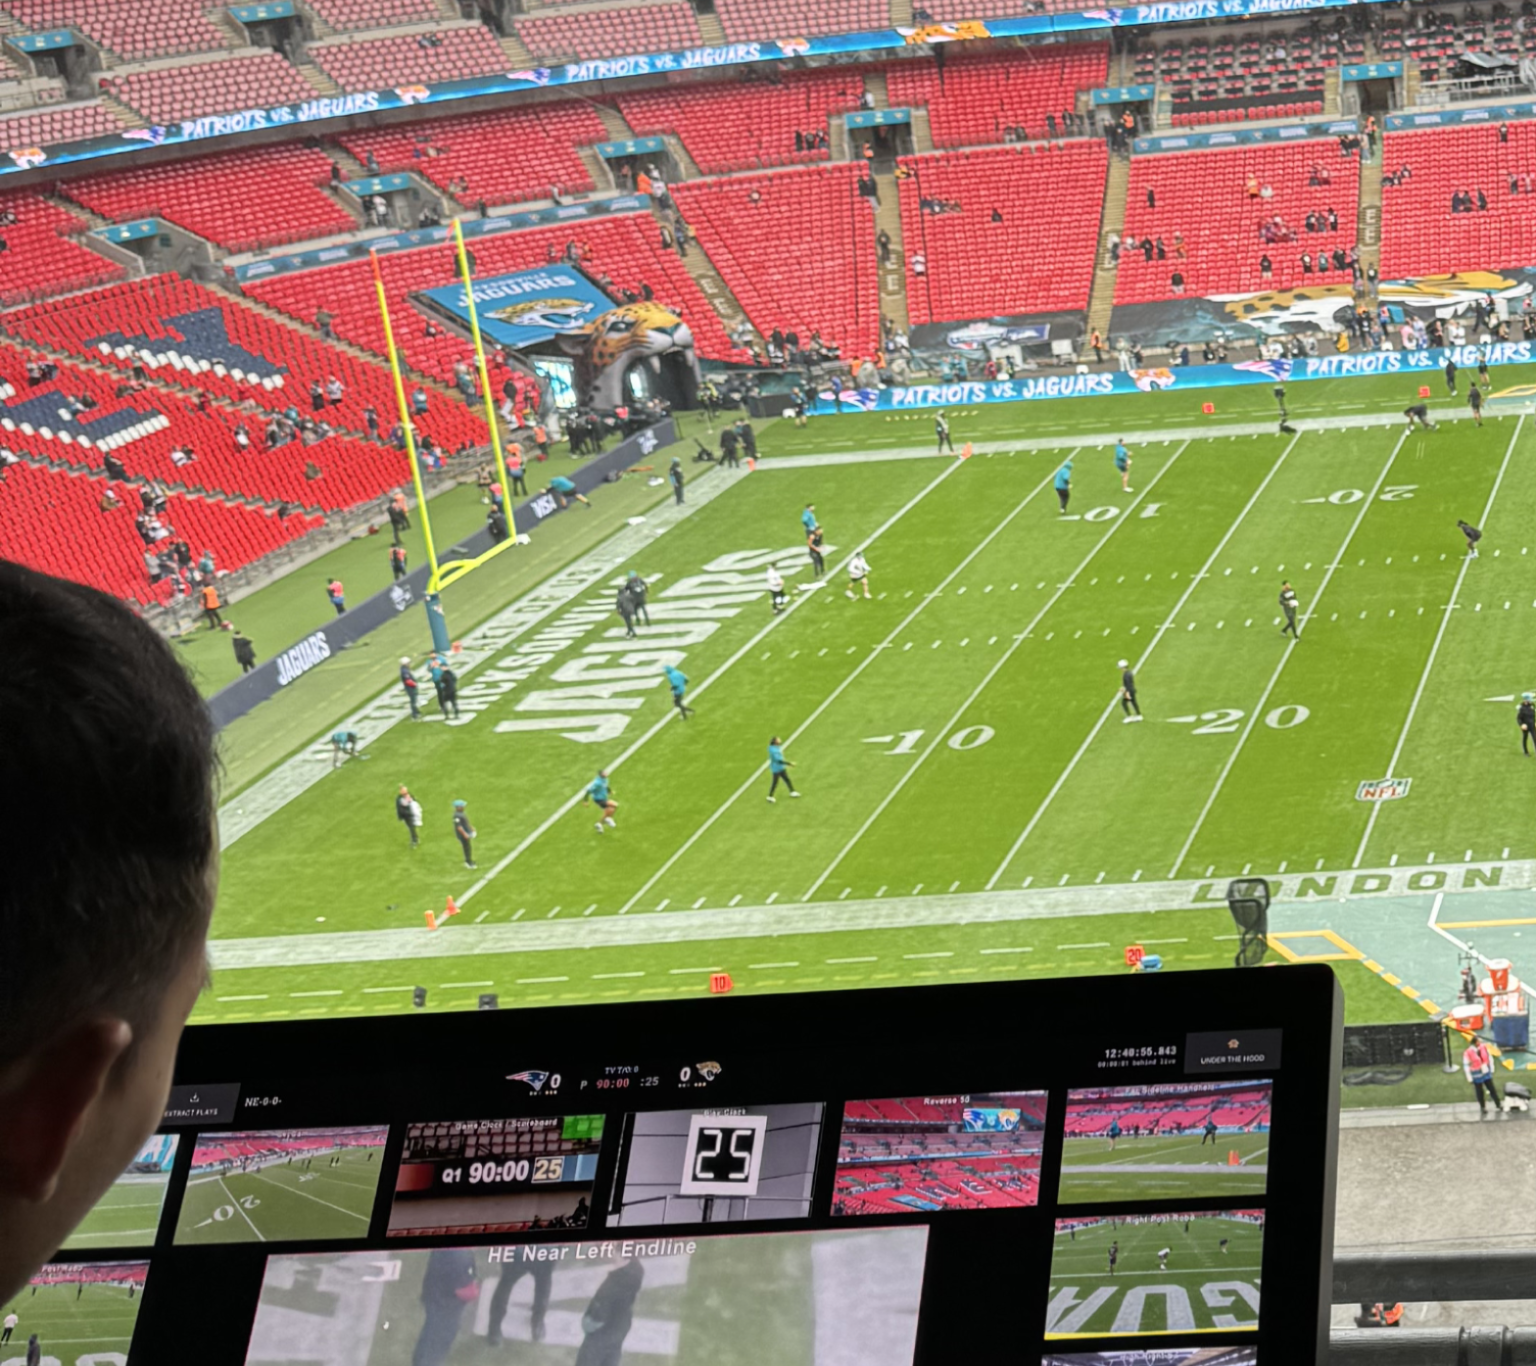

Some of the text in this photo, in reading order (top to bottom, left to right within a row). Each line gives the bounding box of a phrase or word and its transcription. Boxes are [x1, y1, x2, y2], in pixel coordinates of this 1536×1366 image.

[1137, 0, 1218, 23] PATRIOTS
[566, 53, 650, 82] PATRIOTS
[681, 43, 761, 69] JAGUARS
[181, 91, 380, 139] PATRIOTS JAGUARS
[1306, 351, 1401, 376] PATRIOTS
[891, 372, 1114, 407] PATRIOTS JAGUARS
[530, 493, 558, 519] VISA
[493, 544, 838, 744] JAGUARS
[276, 631, 331, 686] JAGUARS
[1363, 786, 1401, 799] NFL
[713, 976, 726, 992] 10
[596, 1077, 630, 1090] 90:00
[695, 1129, 752, 1180] 25
[442, 1158, 562, 1184] Q1 90:00 25
[488, 1238, 697, 1263] HE Near Left Endline
